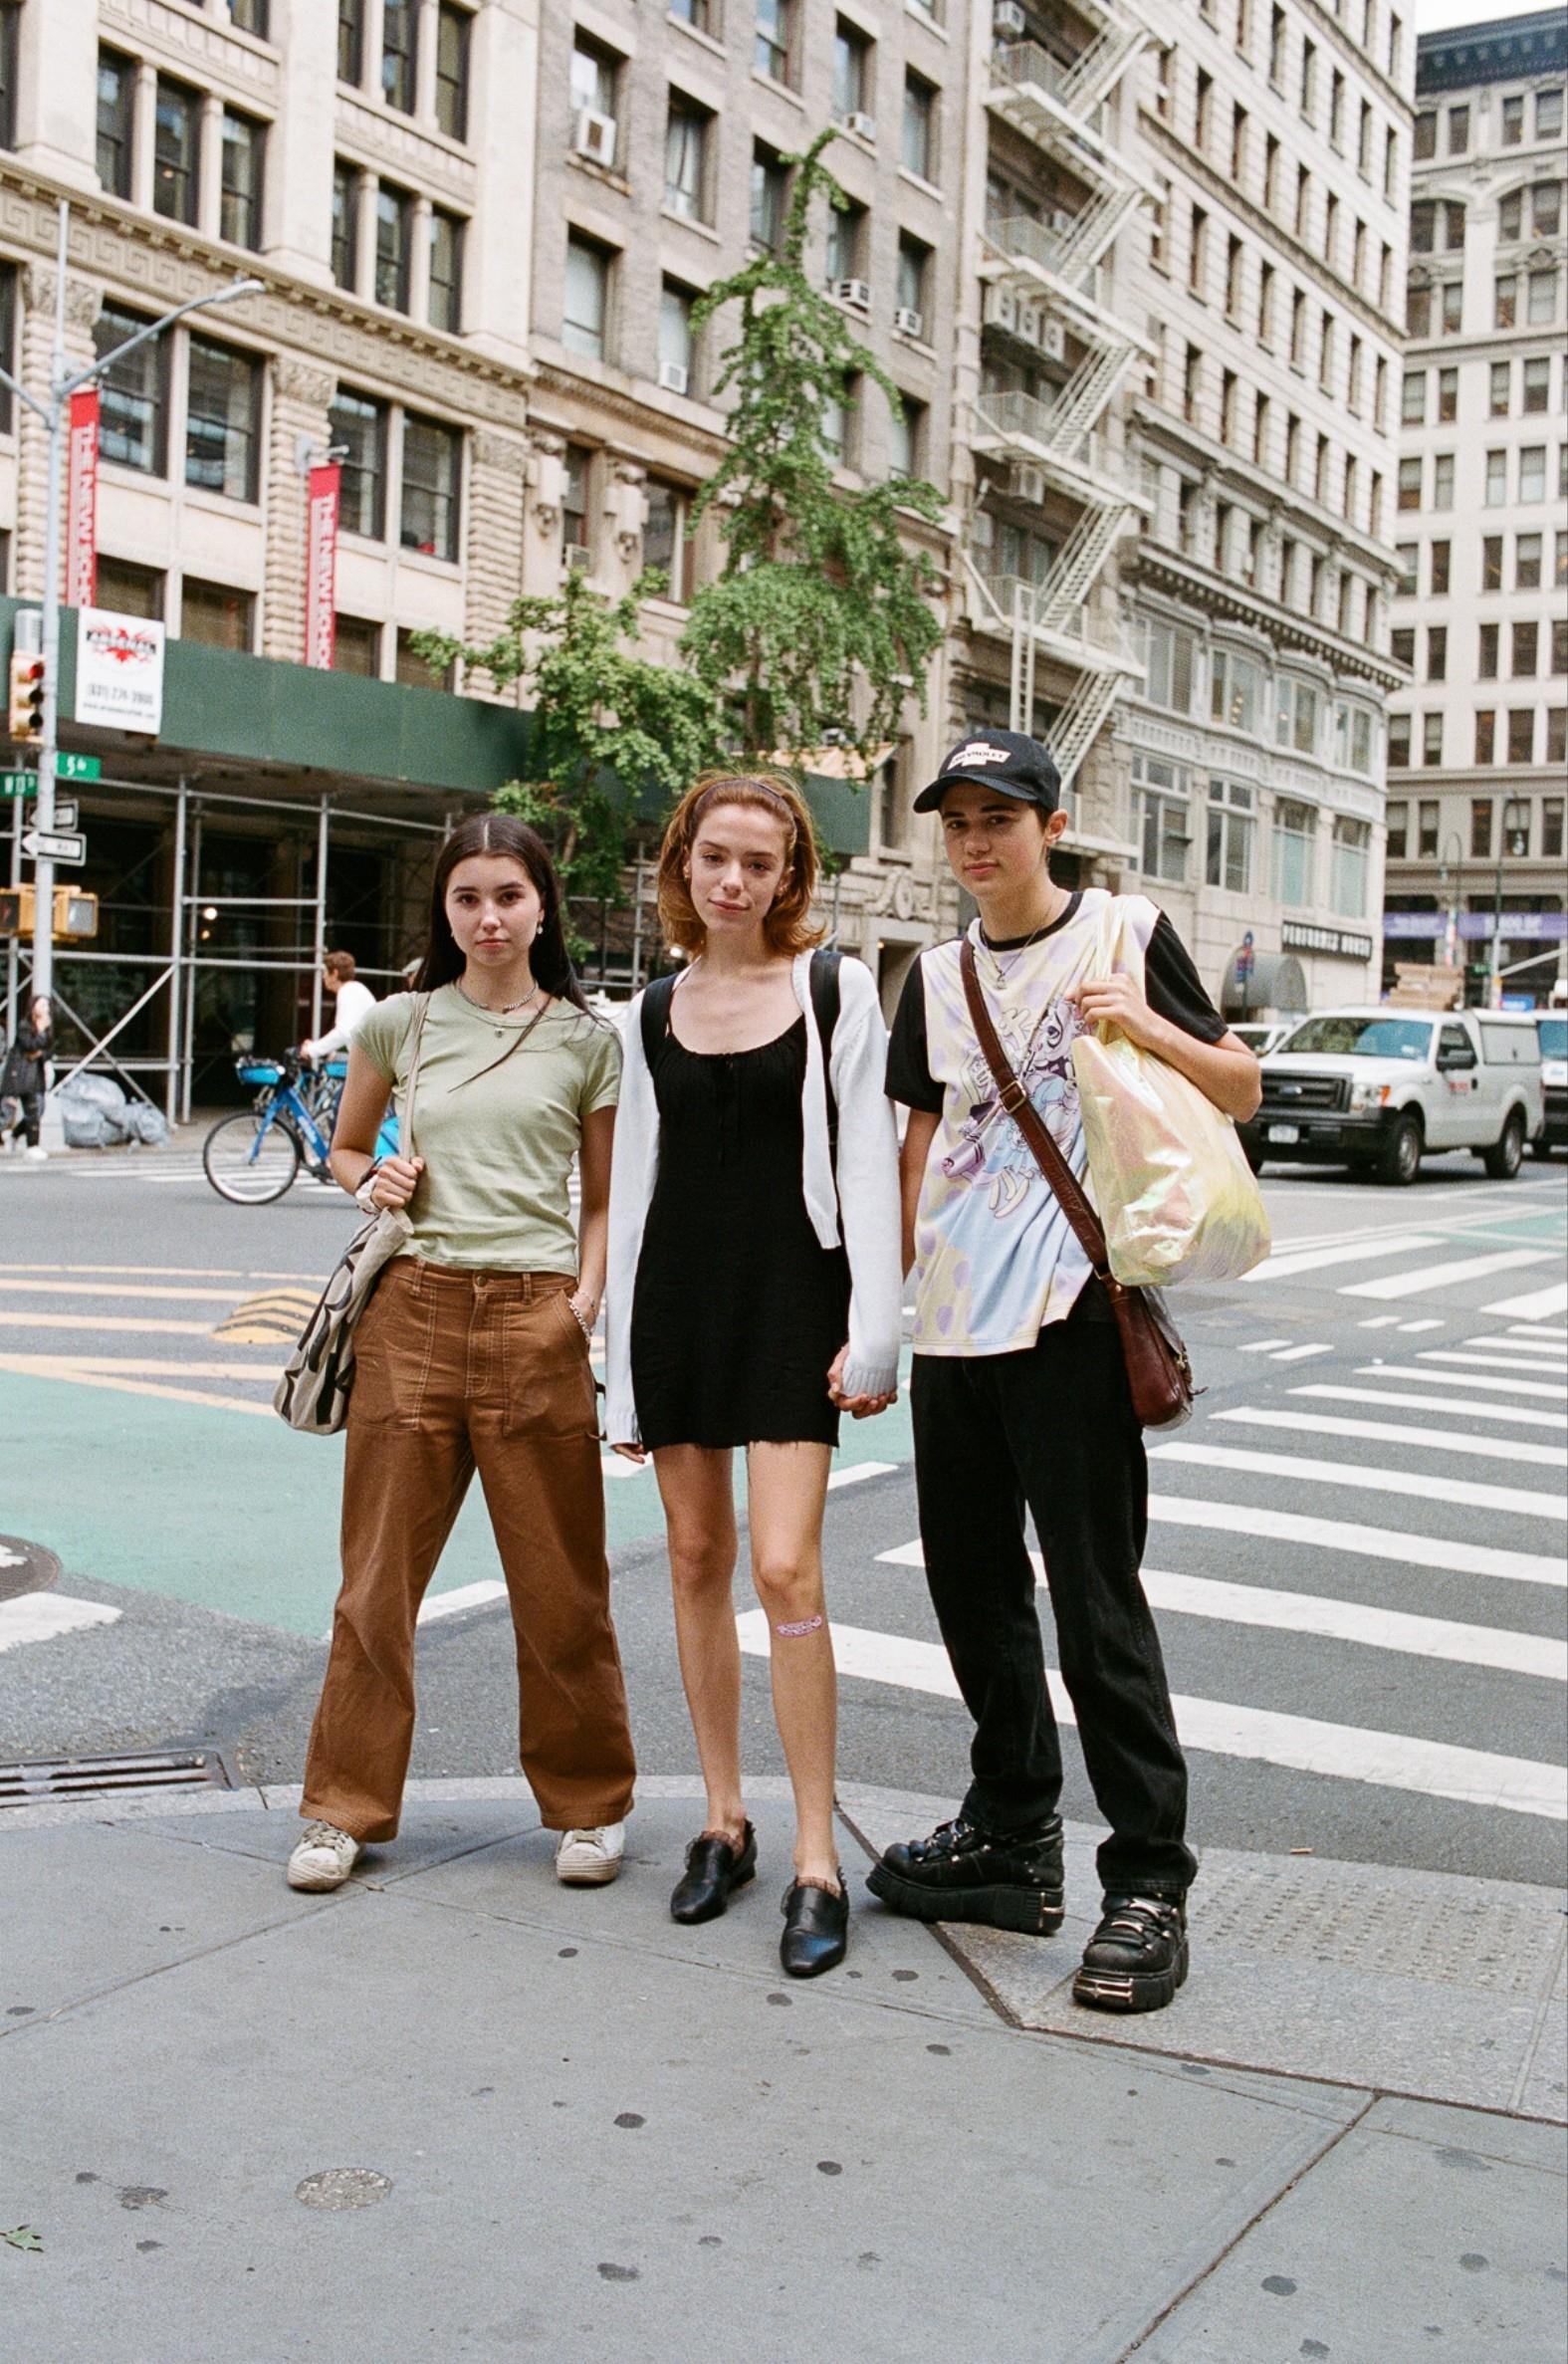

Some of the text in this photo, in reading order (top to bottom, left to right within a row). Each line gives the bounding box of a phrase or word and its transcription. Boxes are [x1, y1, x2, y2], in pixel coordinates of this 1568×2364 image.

[79, 420, 97, 470] THE
[78, 475, 96, 540] NEW
[315, 491, 336, 669] THE NEW SCHO
